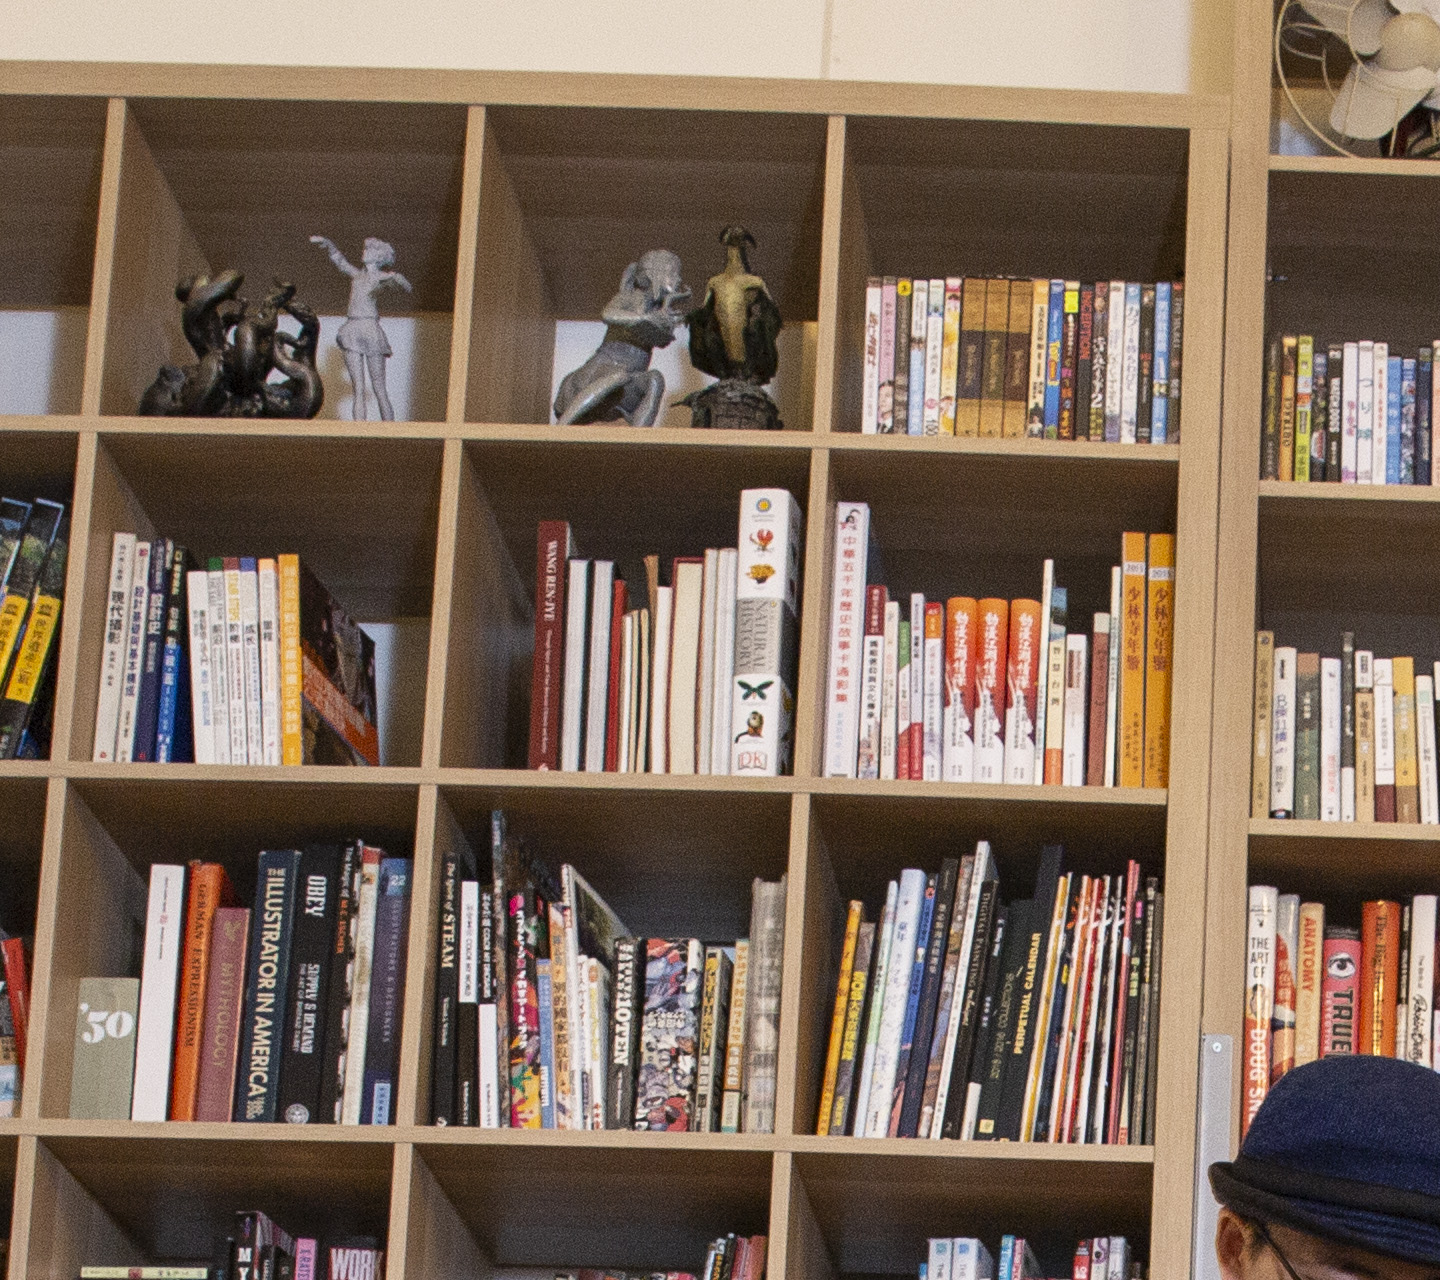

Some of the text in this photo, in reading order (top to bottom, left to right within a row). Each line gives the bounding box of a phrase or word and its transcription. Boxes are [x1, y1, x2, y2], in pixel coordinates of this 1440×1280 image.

[546, 540, 558, 570] WANG
[544, 572, 556, 621] REN-JYE
[740, 600, 753, 670] HISTORY
[754, 601, 768, 668] NATURAL
[741, 754, 763, 770] DK
[343, 860, 353, 884] Magic
[446, 878, 456, 899] Spirit
[304, 875, 327, 918] OBEY
[260, 877, 285, 989] ILLUSTRATOR
[336, 919, 346, 954] ESCHER
[441, 914, 456, 968] STEAM
[1250, 938, 1269, 950] THE
[184, 883, 209, 1048] GERMAN EXPRESSIONISM
[1250, 953, 1269, 965] ART
[1253, 966, 1266, 979] OF
[1299, 917, 1316, 992] ANATOMY
[306, 963, 320, 999] SUPPLY
[1014, 932, 1042, 1054] PERPETUAL CALENDAR
[213, 961, 234, 1069] MYTHOLOGY
[257, 993, 277, 1012] IN
[300, 1012, 315, 1053] DEMAND
[1251, 1028, 1267, 1079] DOUG
[248, 1016, 271, 1097] AMERICA
[937, 1263, 945, 1278] THE
